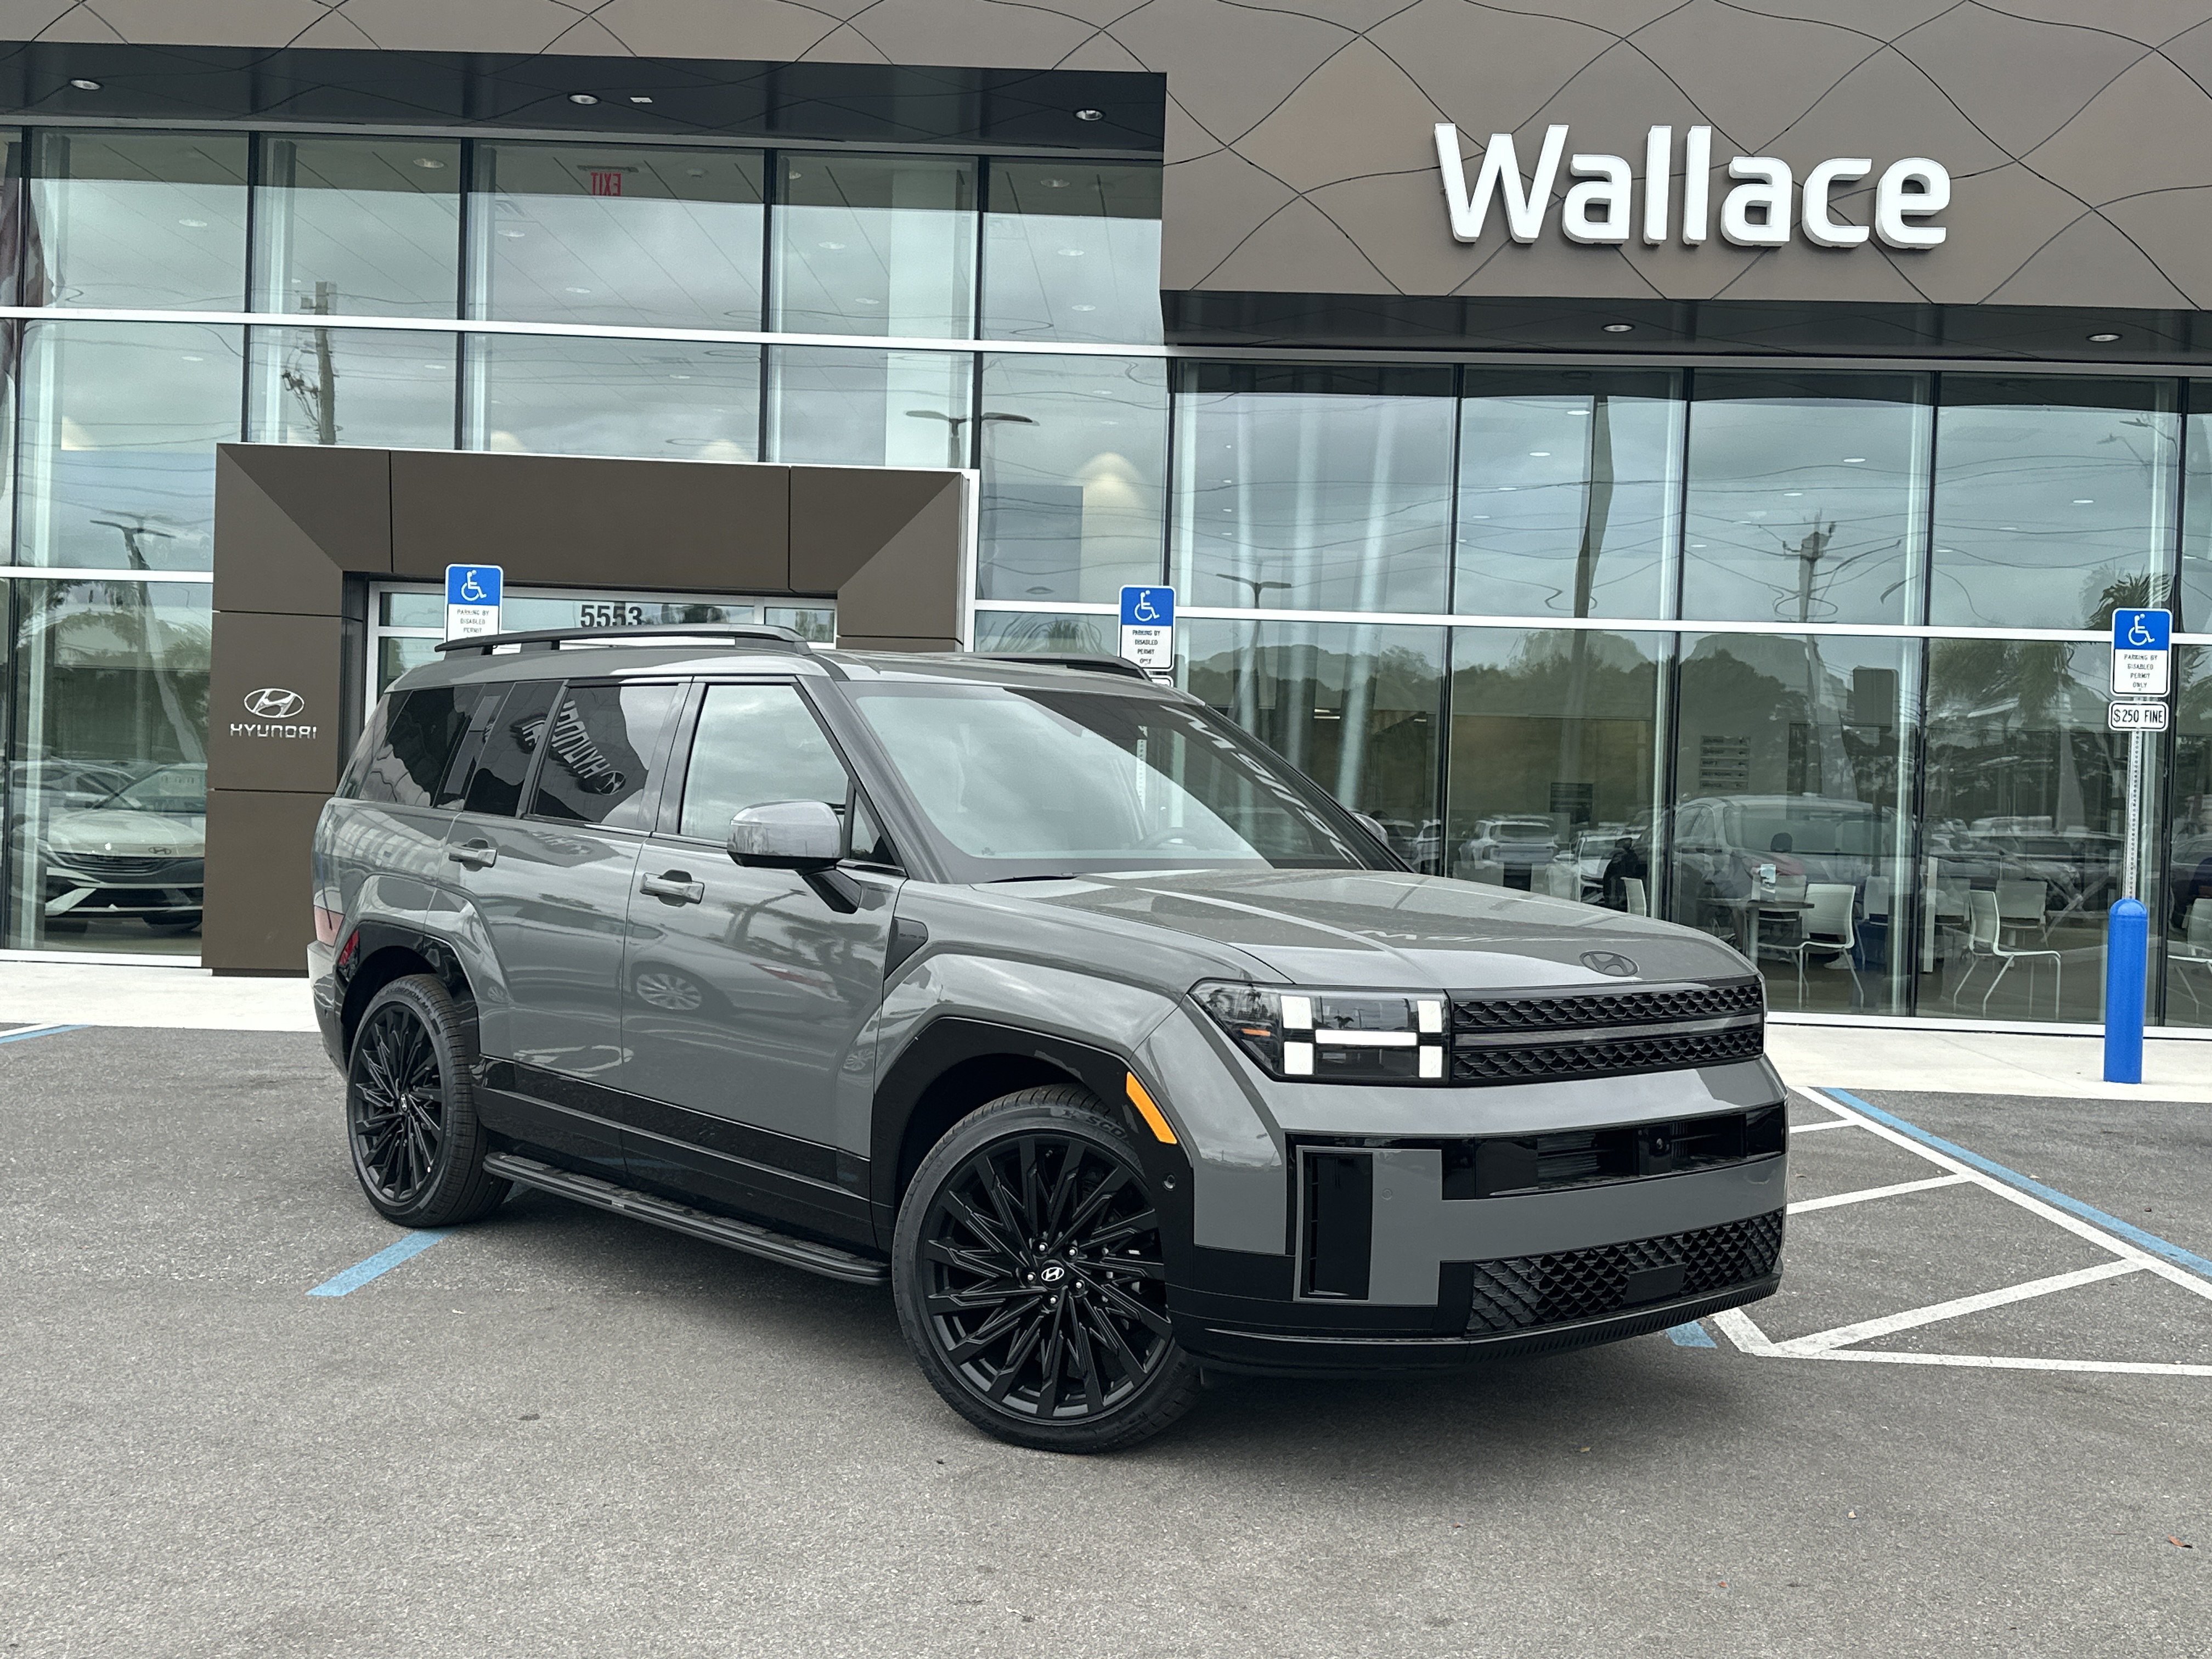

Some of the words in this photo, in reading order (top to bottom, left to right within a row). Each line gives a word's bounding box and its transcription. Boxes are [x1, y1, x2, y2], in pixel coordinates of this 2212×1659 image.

[1434, 123, 1951, 249] Wallace
[580, 604, 642, 628] 5553
[2113, 708, 2140, 724] $250
[2144, 710, 2163, 724] FINE
[230, 723, 317, 739] HYUNDAI
